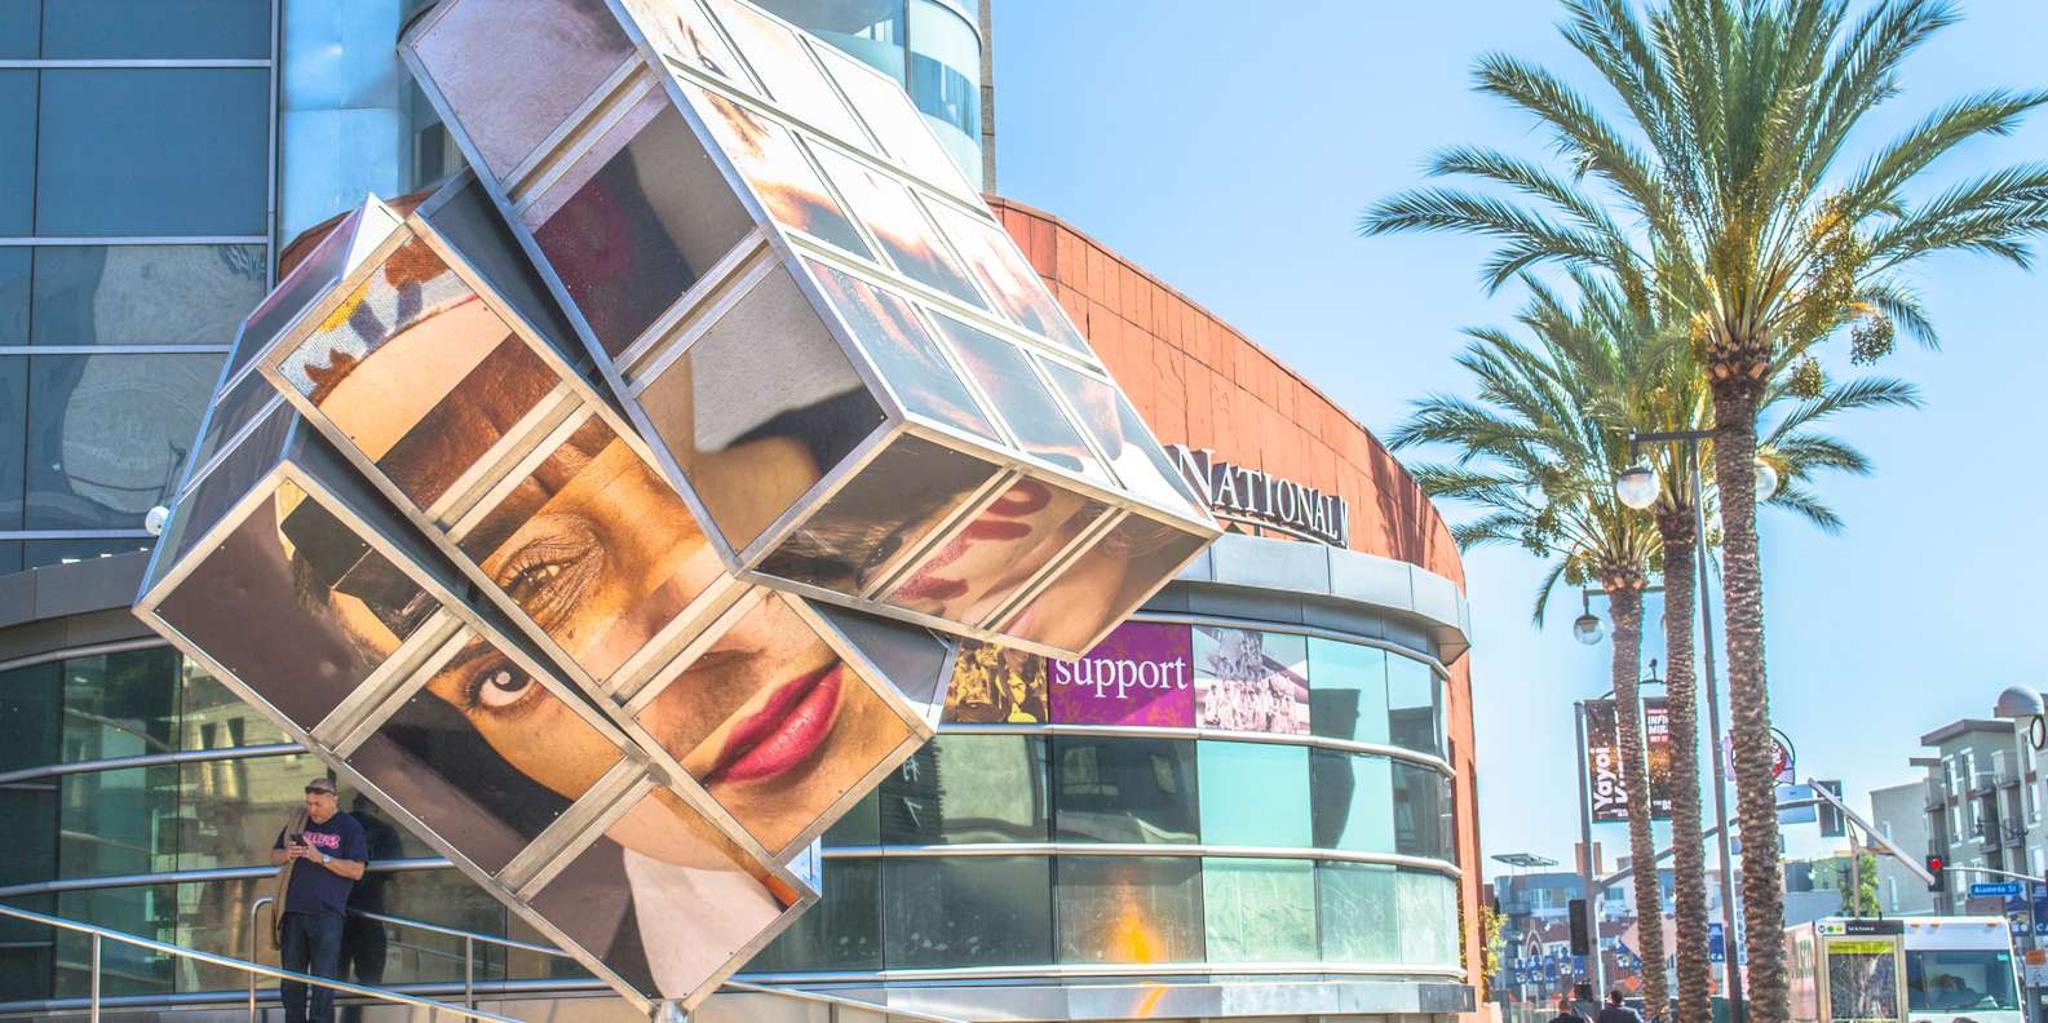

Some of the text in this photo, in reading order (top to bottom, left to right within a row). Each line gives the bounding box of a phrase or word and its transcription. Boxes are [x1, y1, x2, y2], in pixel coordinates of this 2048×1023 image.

[1172, 444, 1338, 541] NATIONAL
[1055, 655, 1188, 699] support
[1590, 747, 1617, 810] Yayoi
[2008, 885, 2017, 893] St
